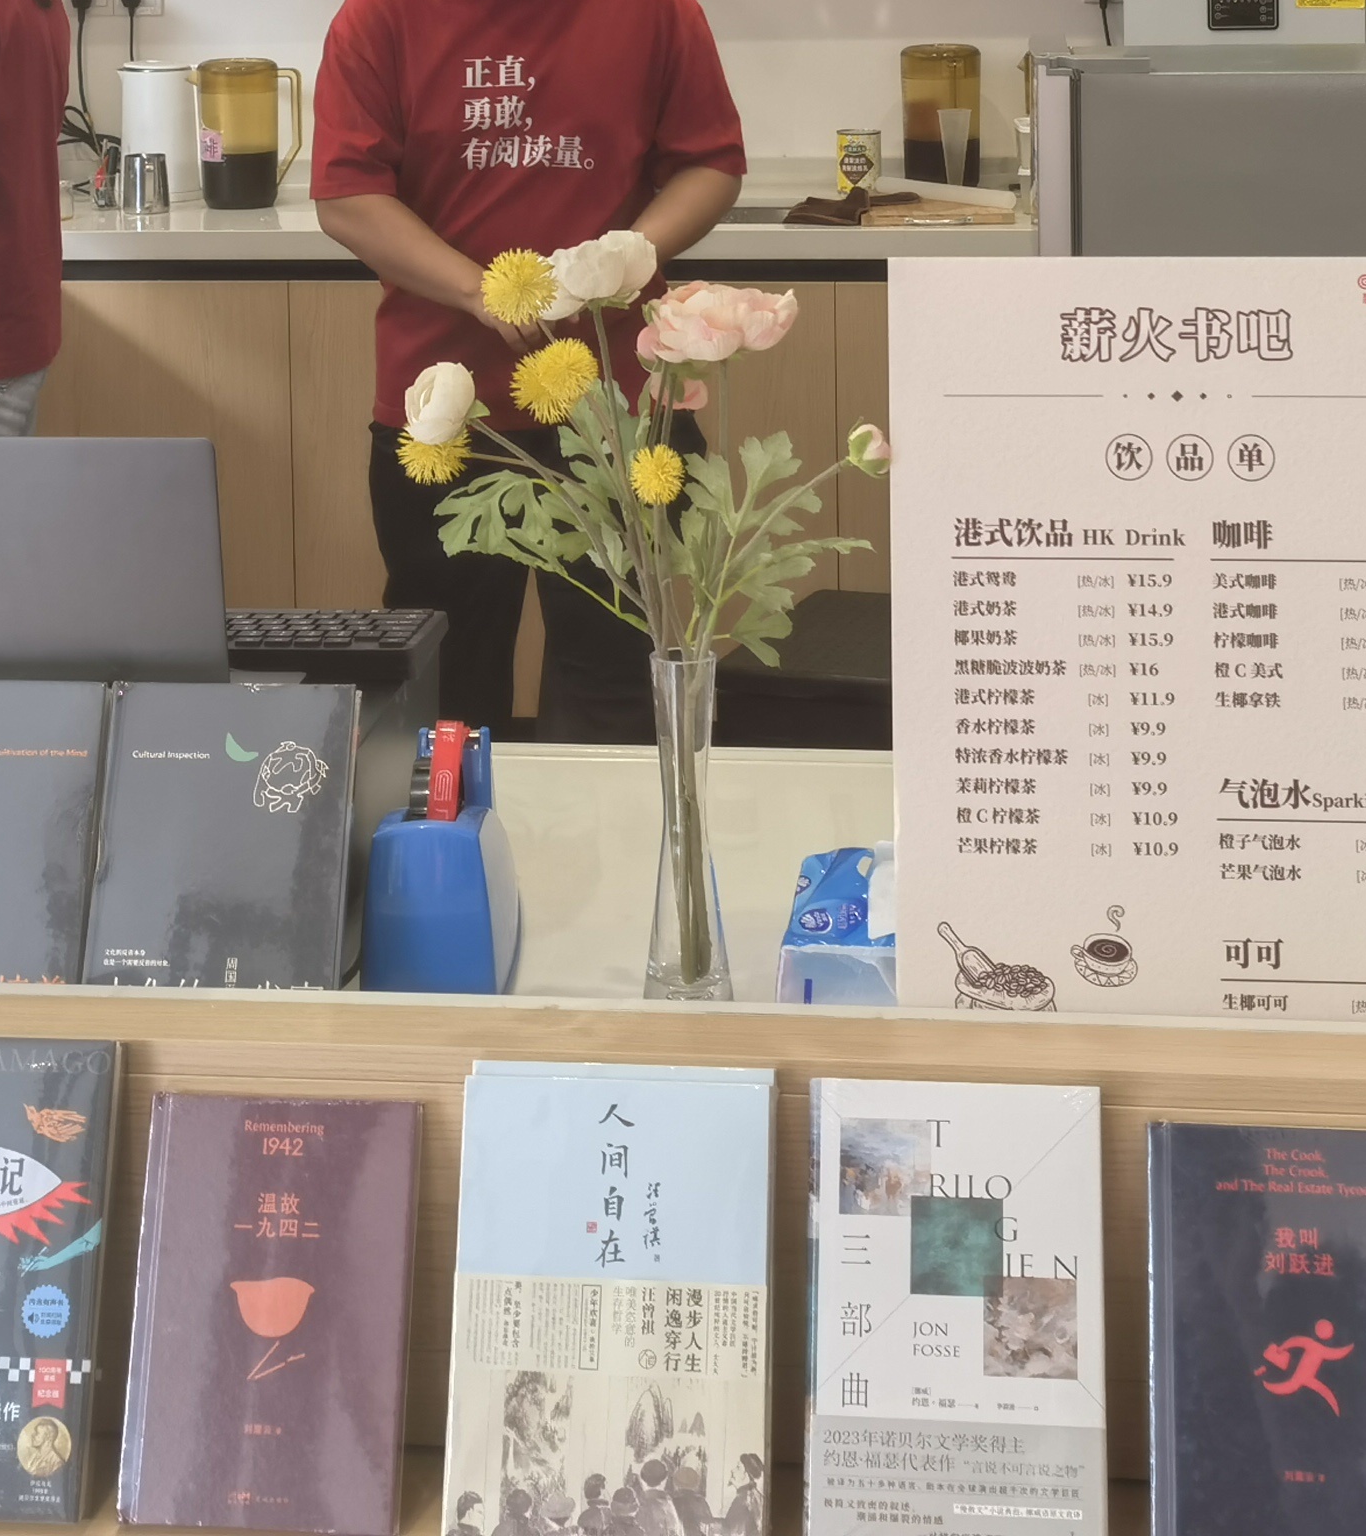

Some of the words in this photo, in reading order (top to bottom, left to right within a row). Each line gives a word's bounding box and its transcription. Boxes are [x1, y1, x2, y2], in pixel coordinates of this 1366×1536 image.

[461, 135, 594, 170] 有阅读量。
[1060, 307, 1293, 362] 薪火书吧
[1112, 441, 1265, 474] 饮品单
[952, 518, 1074, 548] 港式饮品
[1082, 528, 1115, 546] HK
[1125, 527, 1186, 548] Drink
[1211, 519, 1273, 550] 咖啡
[952, 571, 1017, 588] 港式鸳鸯
[1077, 574, 1115, 589] [热/冰]
[1127, 573, 1172, 588] ¥15.9
[1212, 573, 1278, 590] 美式咖啡
[953, 600, 1017, 617] 港式奶茶
[1077, 603, 1115, 619] [热/冰]
[1127, 602, 1173, 618] ¥14.9
[1213, 603, 1279, 620] 港式咖啡
[954, 629, 1018, 647] 椰果奶茶
[1078, 634, 1116, 648] [热/冰]
[1129, 632, 1174, 647] ¥15.9
[1214, 632, 1280, 650] 柠檬咖啡
[953, 659, 1067, 677] 黑糖脆波波奶茶
[1079, 663, 1116, 677] [热/冰]
[1130, 662, 1160, 677] ¥16
[954, 688, 1035, 706] 港式柠檬茶
[1088, 693, 1108, 707] [冰]
[1130, 691, 1176, 706] ¥11.9
[1214, 692, 1282, 710] 生椰拿铁
[955, 718, 1035, 735] 香水柠檬茶
[1089, 722, 1109, 736] [冰]
[1131, 721, 1167, 736] ¥9.9
[39, 748, 49, 757] of
[50, 749, 64, 757] the
[66, 749, 87, 758] Mind
[132, 750, 165, 759] Cultural
[167, 751, 210, 760] Inspection
[955, 748, 1068, 766] 特浓香水柠檬茶
[1089, 752, 1110, 766] [冰]
[1131, 750, 1167, 766] ¥9.9
[955, 778, 1036, 795] 茉莉柠檬茶
[1090, 782, 1110, 796] [冰]
[1132, 781, 1168, 796] ¥9.9
[1219, 778, 1311, 810] 气泡水
[1090, 812, 1111, 826] [冰]
[1132, 810, 1178, 826] ¥10.9
[956, 838, 1038, 855] 芒果柠檬茶
[1090, 842, 1111, 856] [冰]
[1133, 841, 1179, 857] ¥10.9
[1218, 833, 1301, 851] 橙子气泡水
[1219, 864, 1302, 882] 芒果气泡水
[1223, 938, 1284, 970] 可可
[1222, 994, 1289, 1011] 生椰可可
[244, 1120, 325, 1136] Remembering
[927, 1119, 950, 1148] T
[263, 1138, 304, 1157] 1942
[1265, 1148, 1287, 1161] The
[1263, 1164, 1285, 1177] The
[594, 1103, 636, 1268] 人间自在
[928, 1173, 1012, 1199] RILO
[1216, 1181, 1239, 1192] and
[1243, 1180, 1265, 1193] The
[1268, 1181, 1294, 1194] Real
[1297, 1182, 1334, 1195] Estate
[258, 1192, 300, 1215] 温故
[234, 1218, 321, 1238] 一九四二
[994, 1216, 1019, 1242] G
[1275, 1228, 1320, 1250] 我叫
[1265, 1252, 1335, 1276] 刘跃进
[611, 1286, 624, 1334] 生存哲学
[625, 1286, 636, 1347] 唯美恣意的
[641, 1287, 656, 1335] 汪曾祺
[664, 1287, 682, 1372] 闲逸穿行
[685, 1288, 703, 1373] 漫步人生
[840, 1232, 873, 1410] 三部曲
[912, 1321, 948, 1338] JON
[913, 1343, 960, 1358] FOSSE
[823, 1429, 1025, 1455] 2023年诺贝尔文学奖得主
